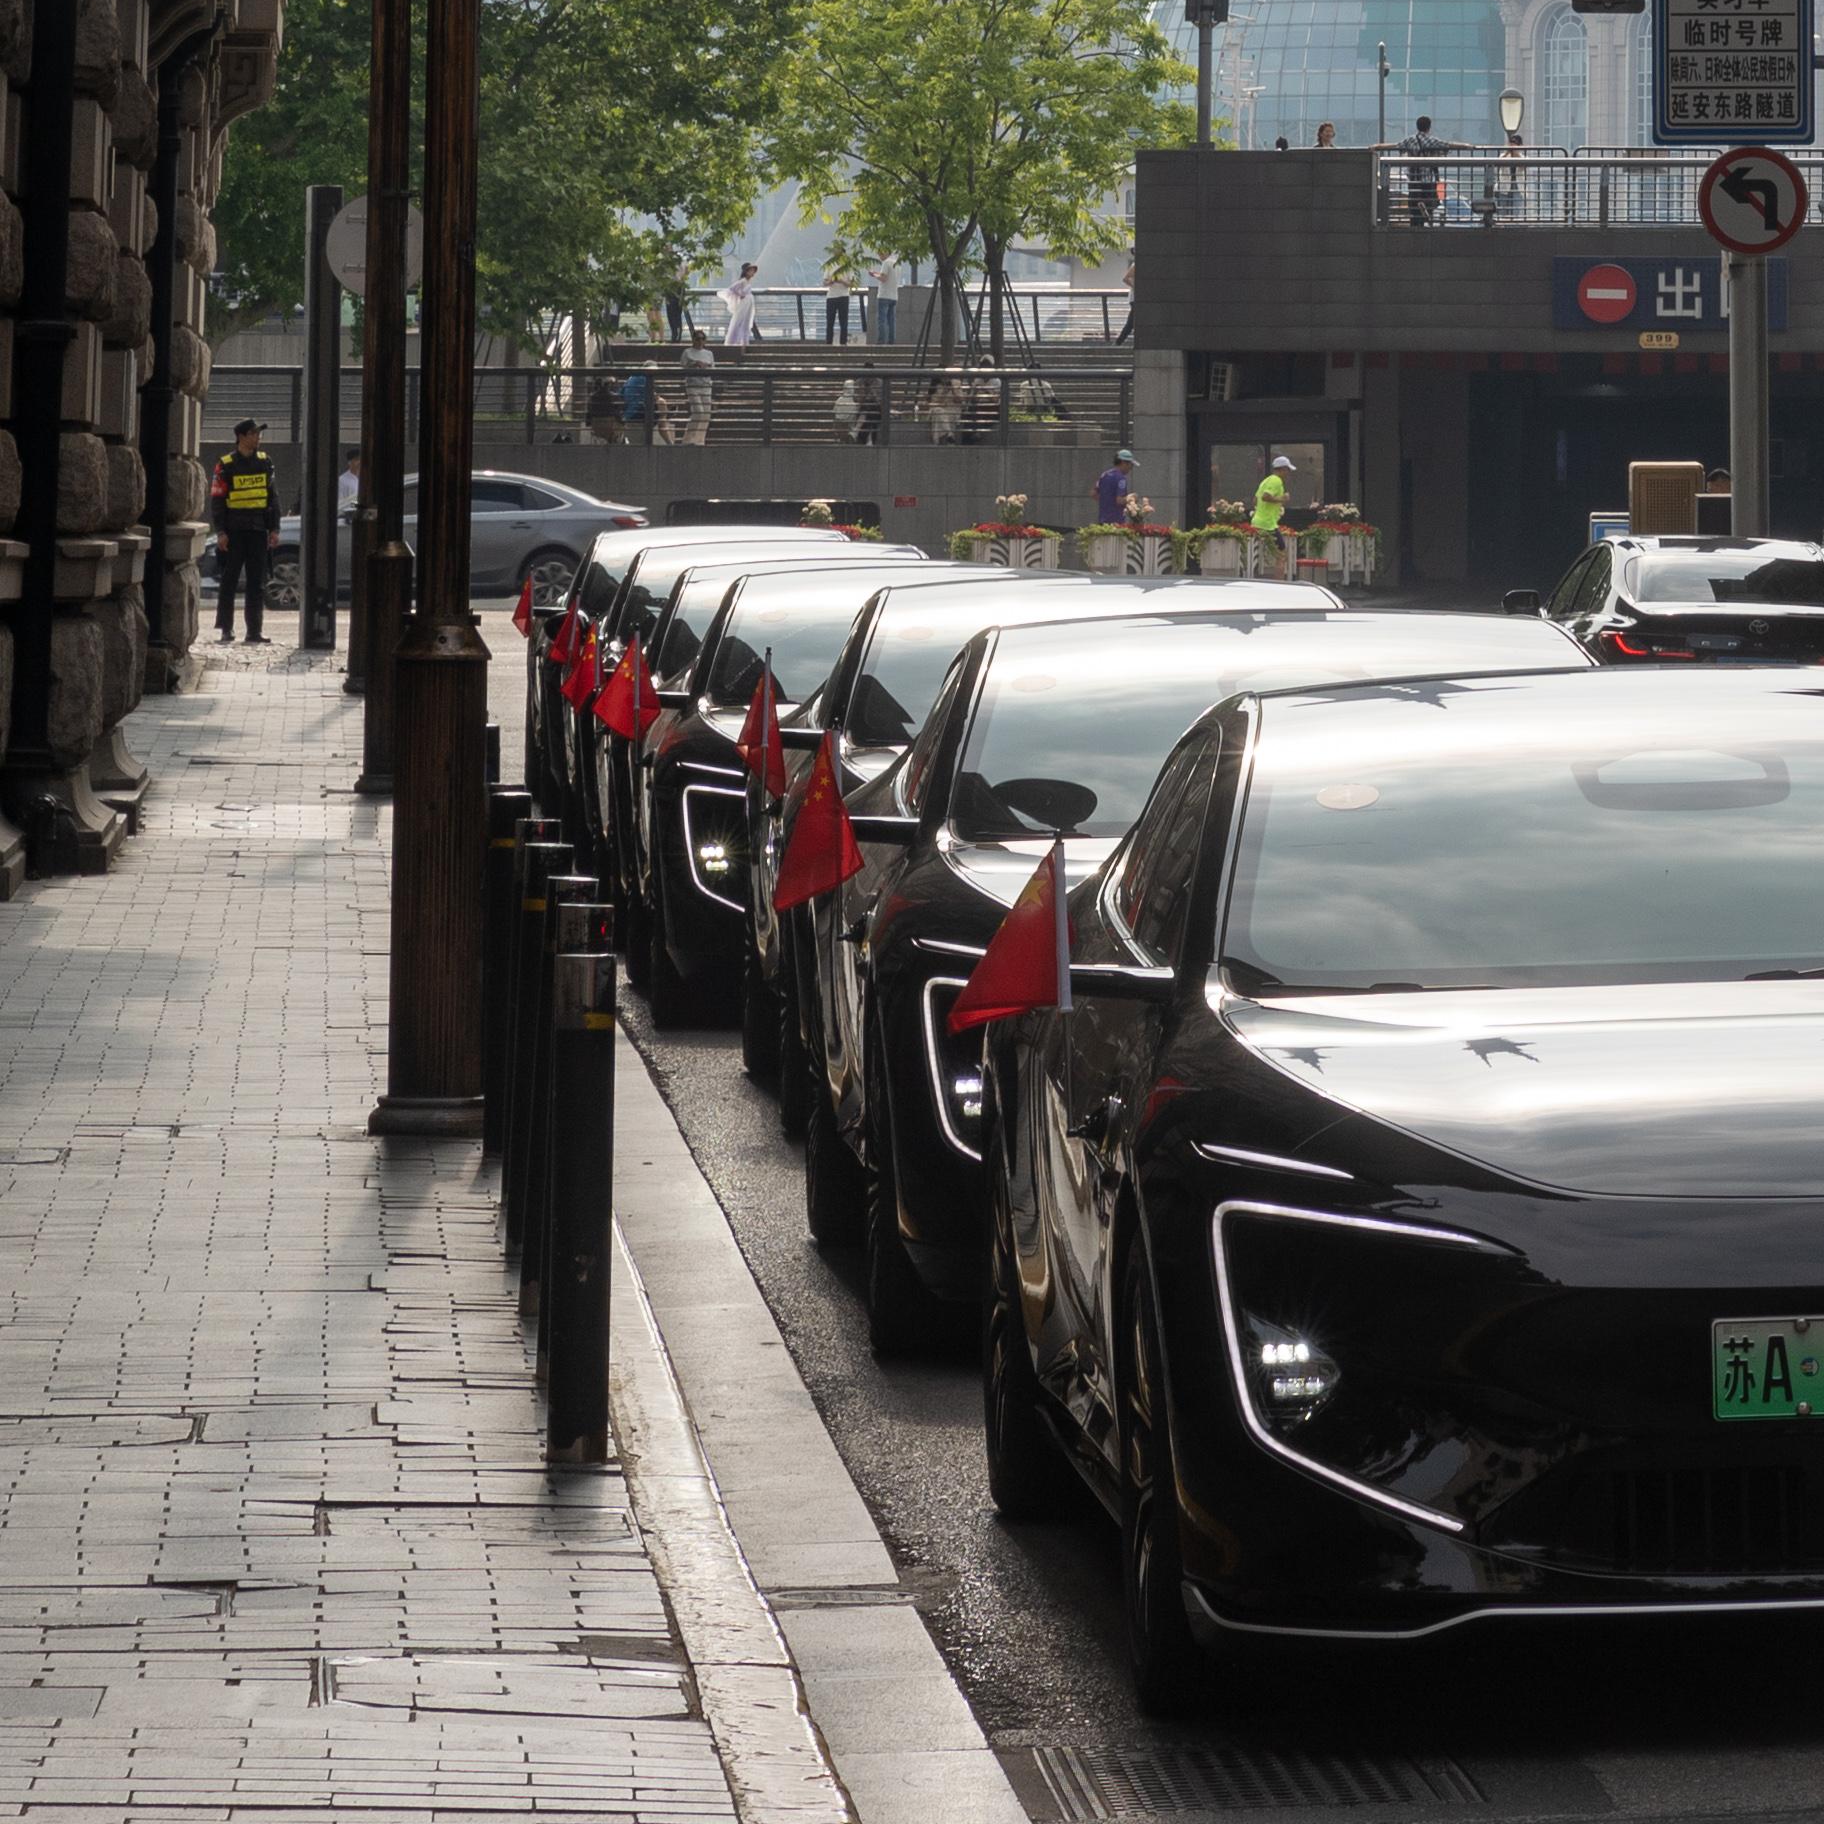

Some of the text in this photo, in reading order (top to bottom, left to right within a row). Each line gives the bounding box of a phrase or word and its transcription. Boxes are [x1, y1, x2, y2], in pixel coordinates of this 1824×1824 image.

[1684, 20, 1783, 46] 临时号牌
[1671, 56, 1795, 83] 除周六、日和全体公民放假日外
[1671, 92, 1795, 119] 延安东路隧道
[1656, 266, 1731, 320] 出
